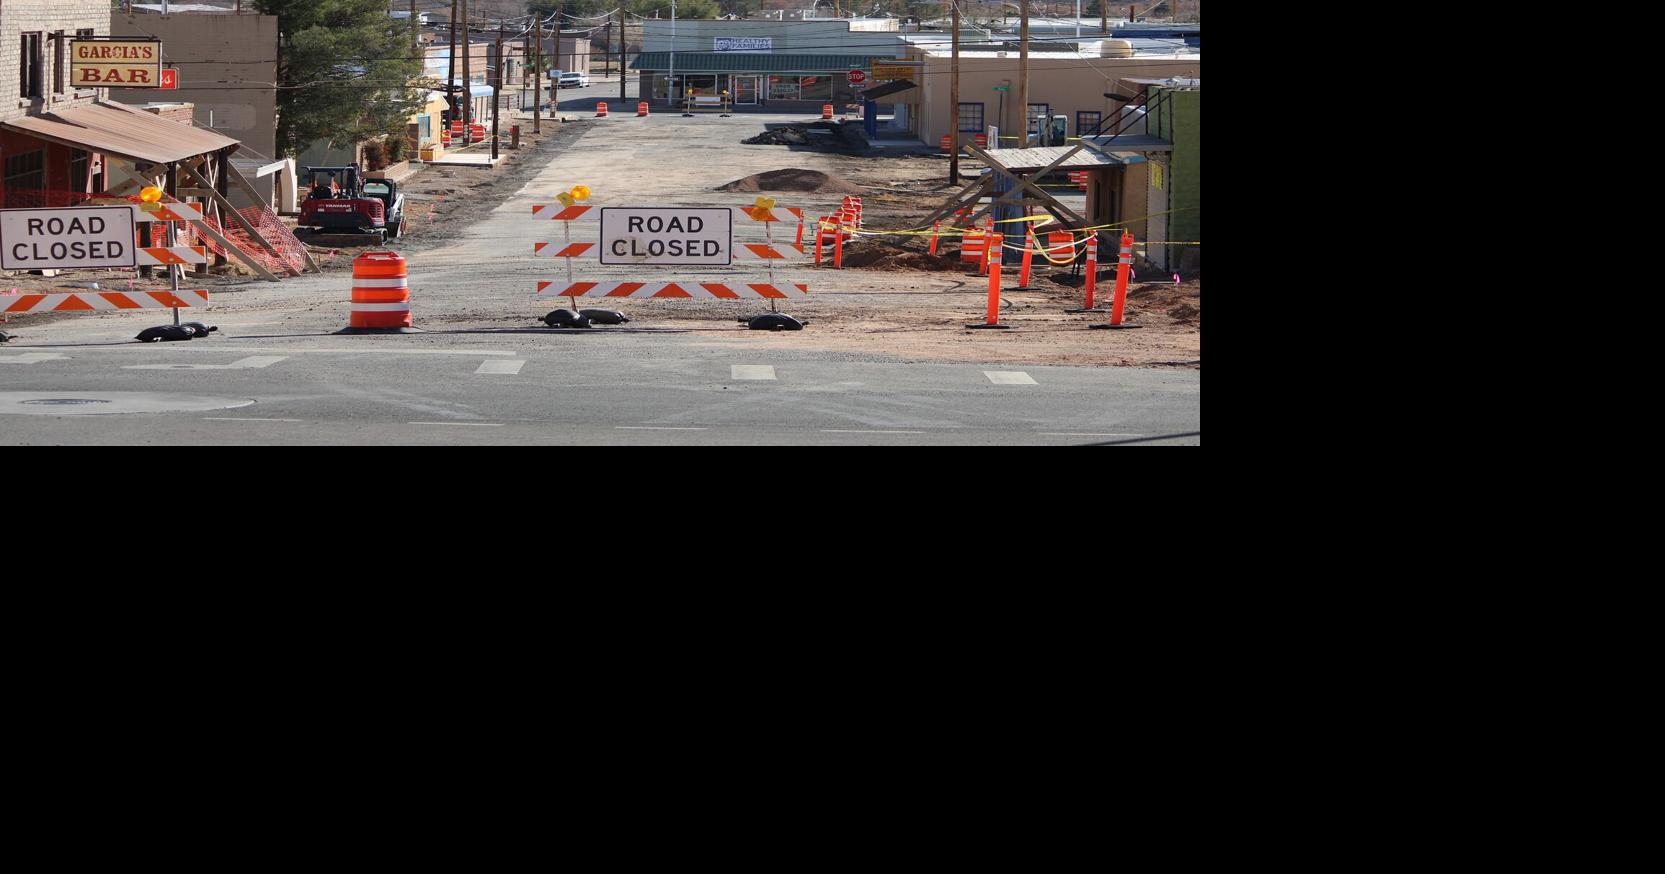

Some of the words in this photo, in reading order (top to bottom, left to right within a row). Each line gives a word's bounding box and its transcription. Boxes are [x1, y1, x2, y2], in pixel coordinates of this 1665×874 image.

[78, 46, 153, 59] GARCIA'S
[79, 68, 151, 83] BAR
[27, 216, 106, 236] ROAD
[628, 215, 704, 233] ROAD
[12, 241, 124, 261] CLOSED
[611, 239, 720, 257] CLOSED
